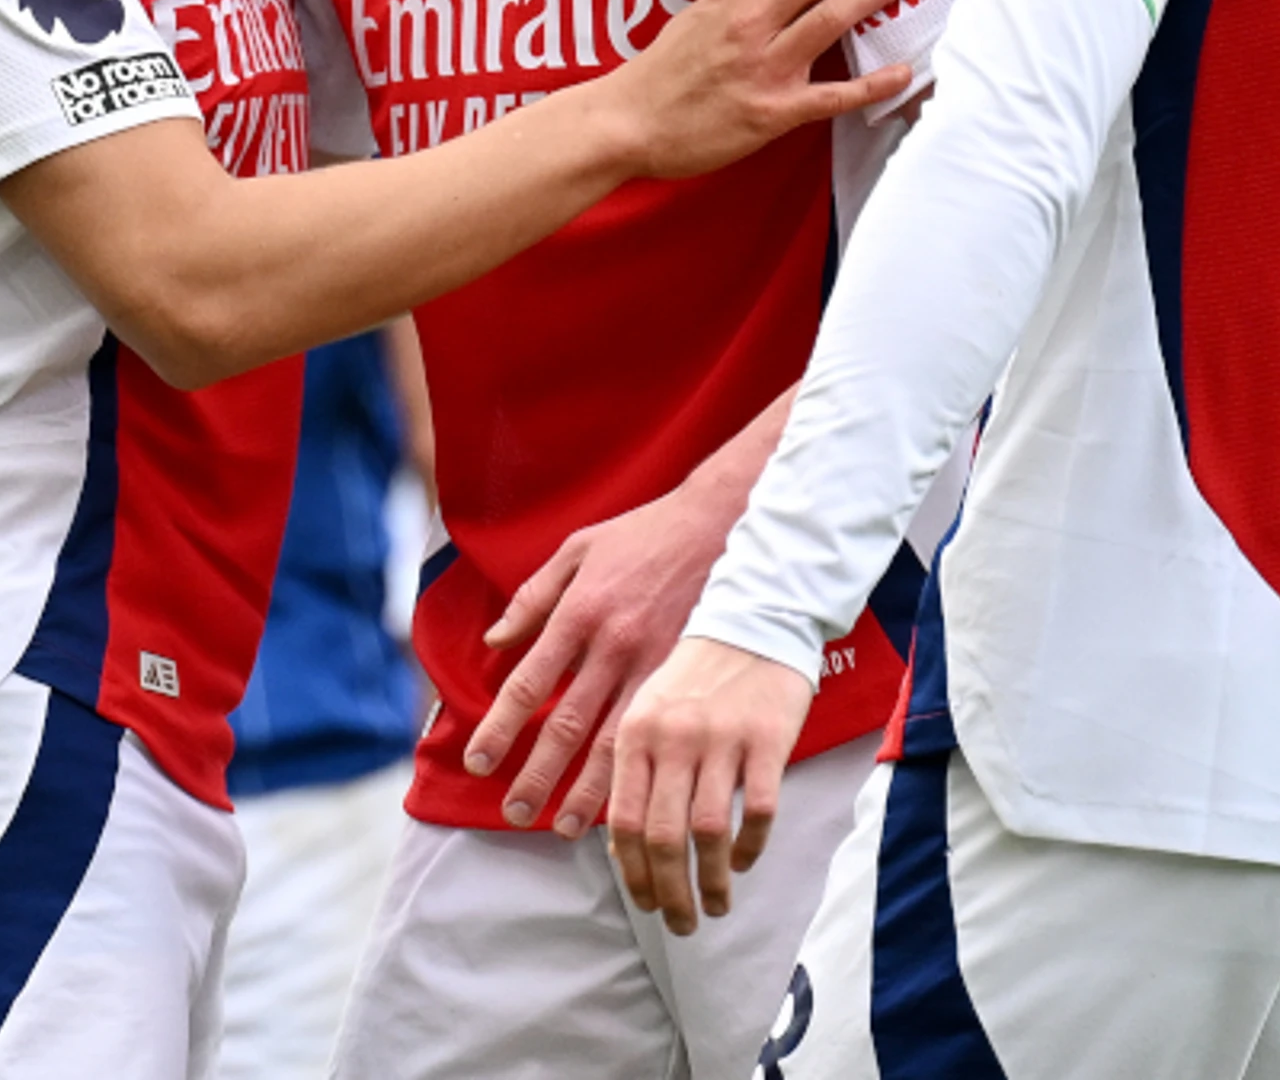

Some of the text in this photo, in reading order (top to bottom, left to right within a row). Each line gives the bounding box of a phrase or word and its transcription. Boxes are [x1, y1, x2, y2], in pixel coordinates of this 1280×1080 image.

[53, 57, 171, 101] No room
[390, 99, 448, 157] FLY
